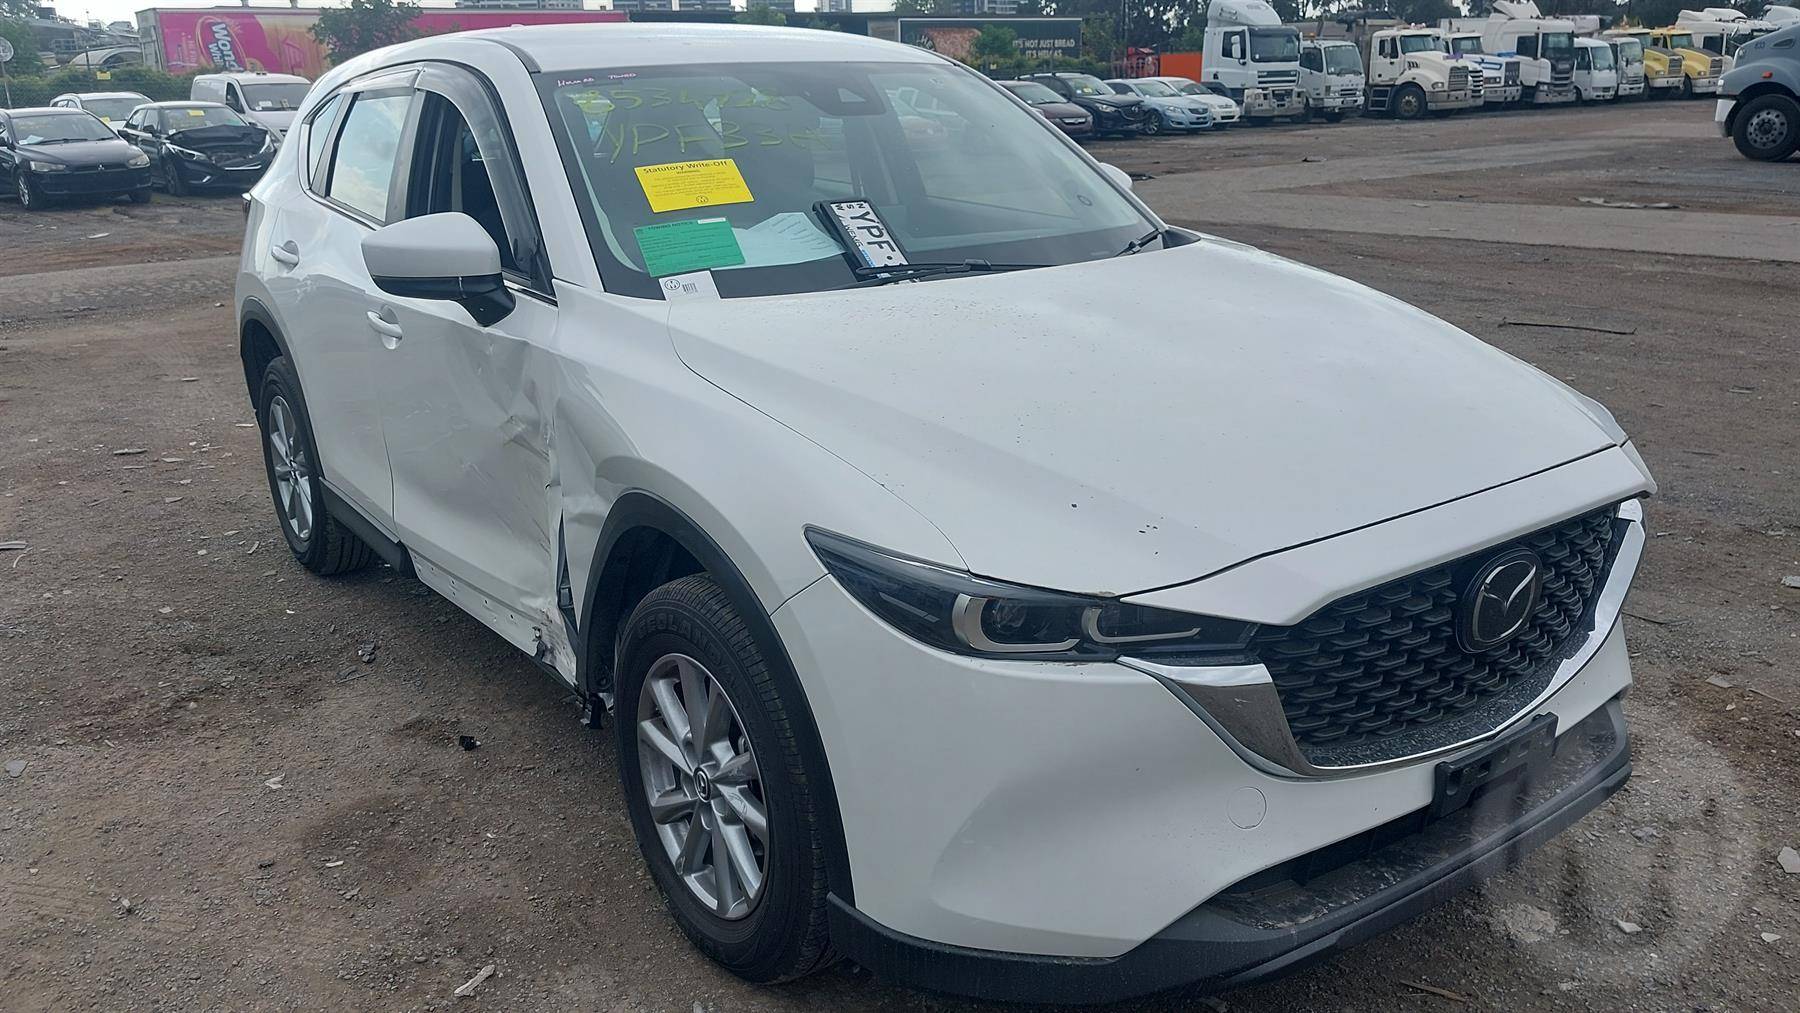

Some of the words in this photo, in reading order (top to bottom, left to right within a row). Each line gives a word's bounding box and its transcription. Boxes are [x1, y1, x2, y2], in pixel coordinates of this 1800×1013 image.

[1025, 39, 1038, 48] NOT
[1039, 39, 1054, 48] JUST
[1054, 38, 1076, 48] BREAD
[643, 164, 684, 174] Statutory
[686, 160, 728, 169] Write-Off
